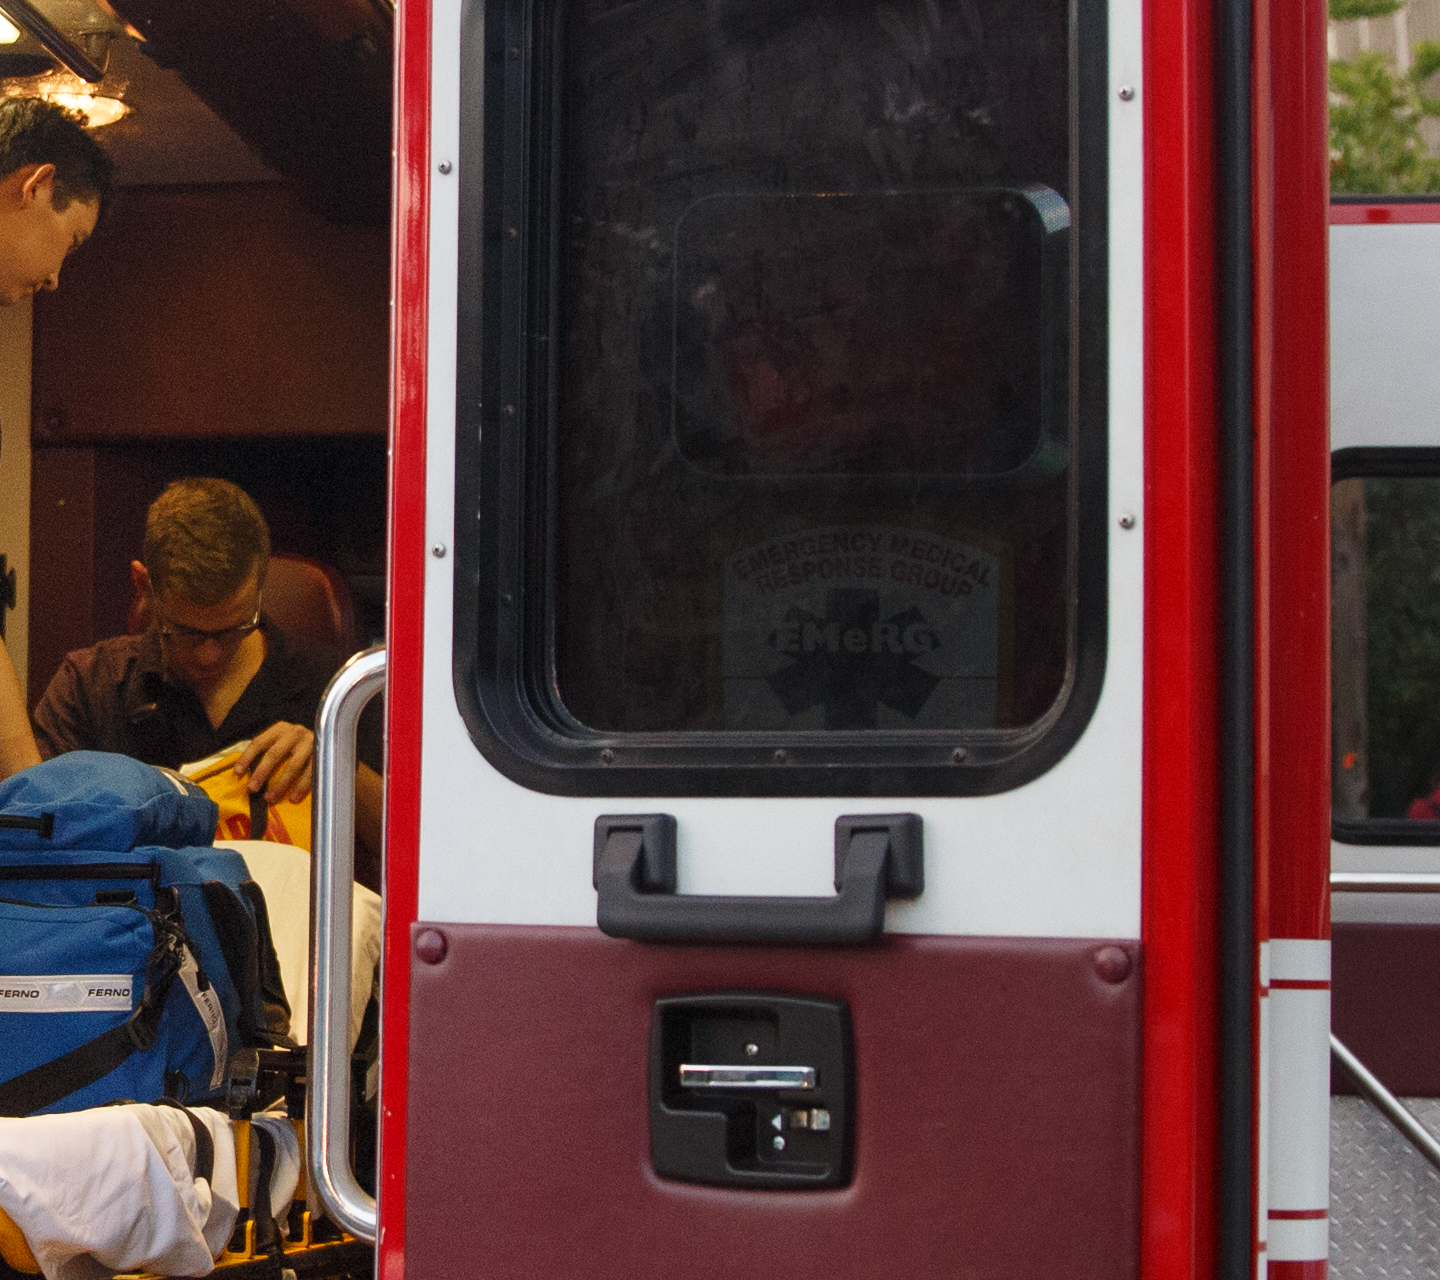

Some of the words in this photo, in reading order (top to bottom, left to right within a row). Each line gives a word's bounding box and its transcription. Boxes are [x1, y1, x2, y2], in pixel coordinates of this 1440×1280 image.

[731, 530, 884, 581] EMERGENCY
[889, 533, 992, 588] MEDICAL
[756, 556, 883, 596] RESPONSE
[889, 559, 974, 599] GROUP
[87, 987, 130, 997] FERNO
